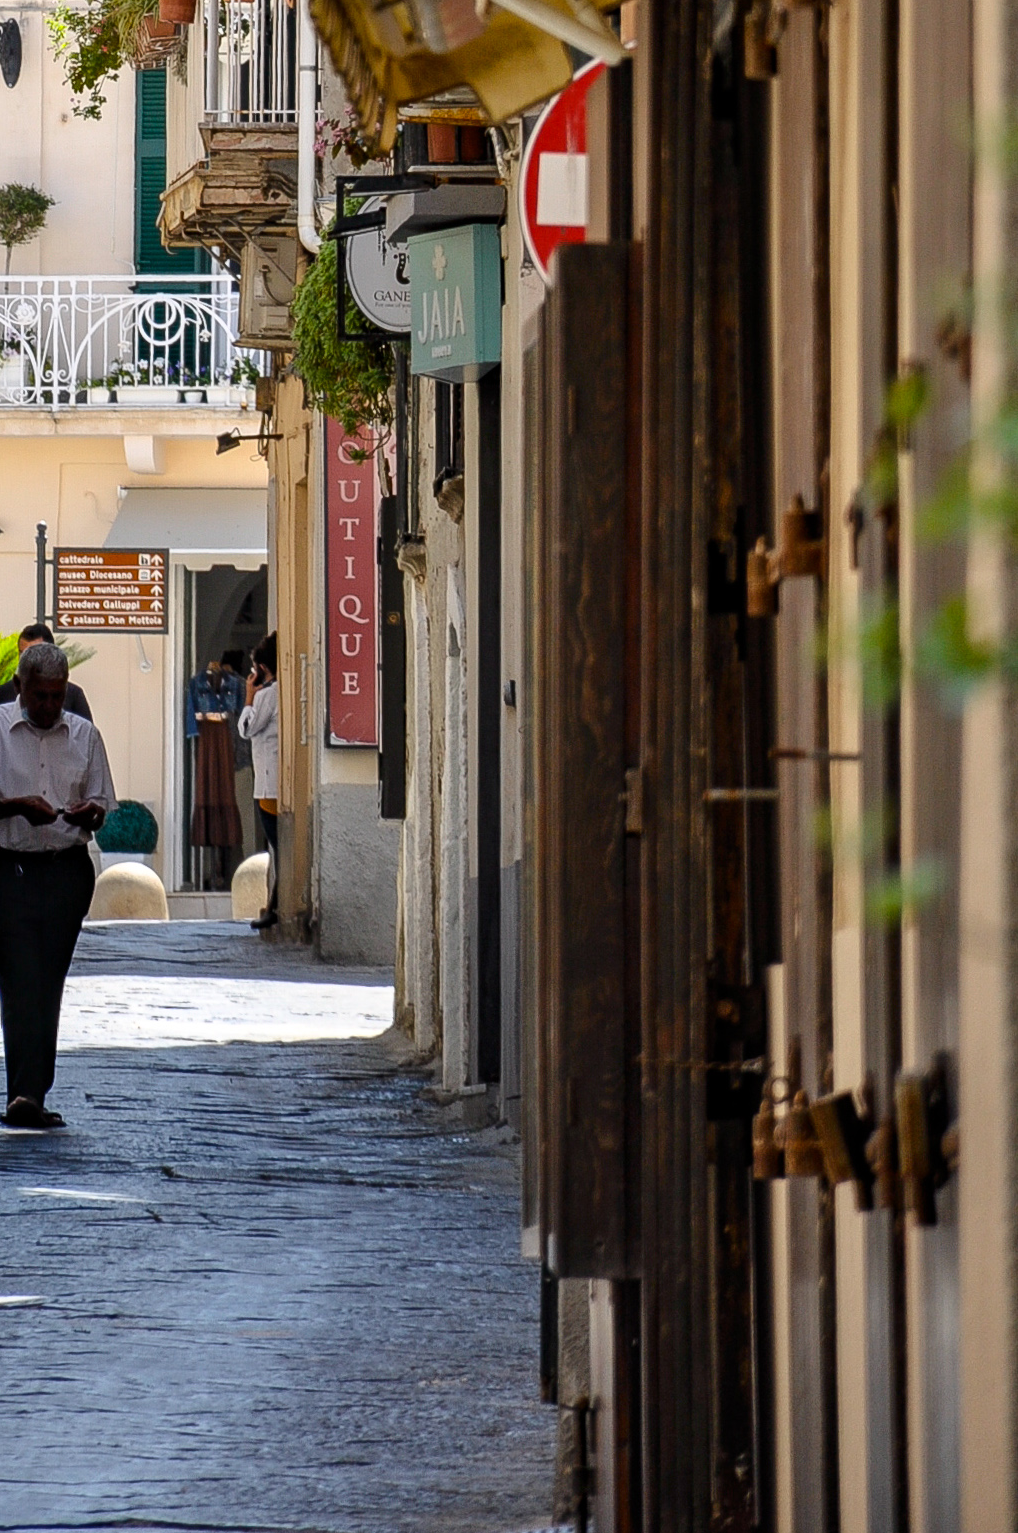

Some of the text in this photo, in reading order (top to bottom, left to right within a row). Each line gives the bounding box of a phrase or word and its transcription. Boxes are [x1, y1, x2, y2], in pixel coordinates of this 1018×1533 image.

[373, 289, 412, 303] GANE
[417, 285, 466, 345] JAIA
[59, 555, 104, 565] cattedrale
[337, 422, 370, 697] OUTIQUE
[59, 570, 133, 580] museo Diocesano
[59, 585, 140, 595] palazzo municipale
[59, 600, 140, 610] belvedere Galluppi
[73, 615, 162, 625] palazzo Don Mottola
